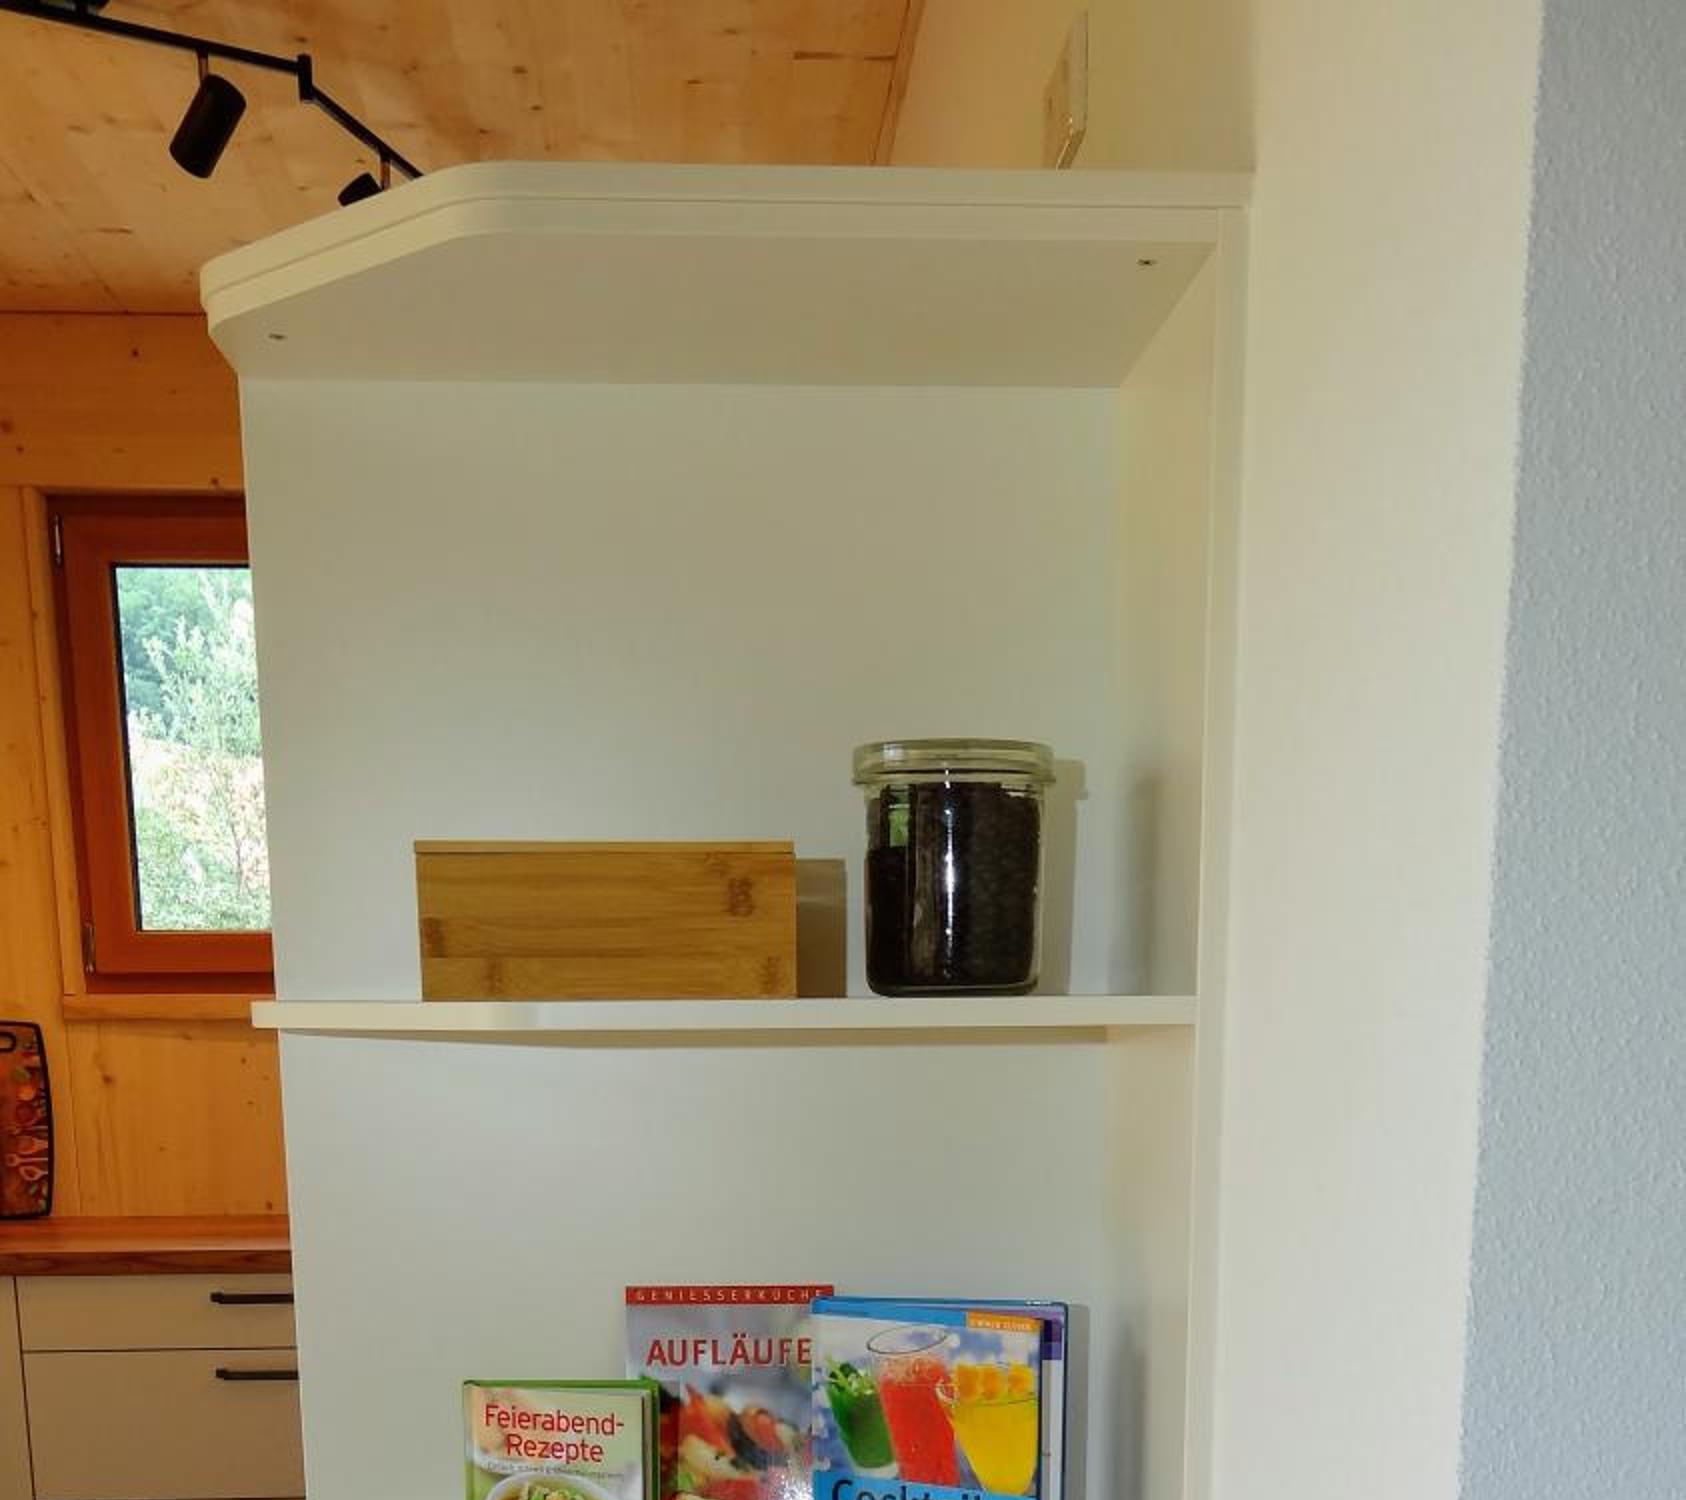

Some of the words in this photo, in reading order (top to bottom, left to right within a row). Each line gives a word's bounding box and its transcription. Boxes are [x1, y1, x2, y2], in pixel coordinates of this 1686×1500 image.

[646, 1332, 812, 1367] AUFLÄUFE
[484, 1403, 625, 1436] Feierabend-
[506, 1432, 605, 1464] Rezepte
